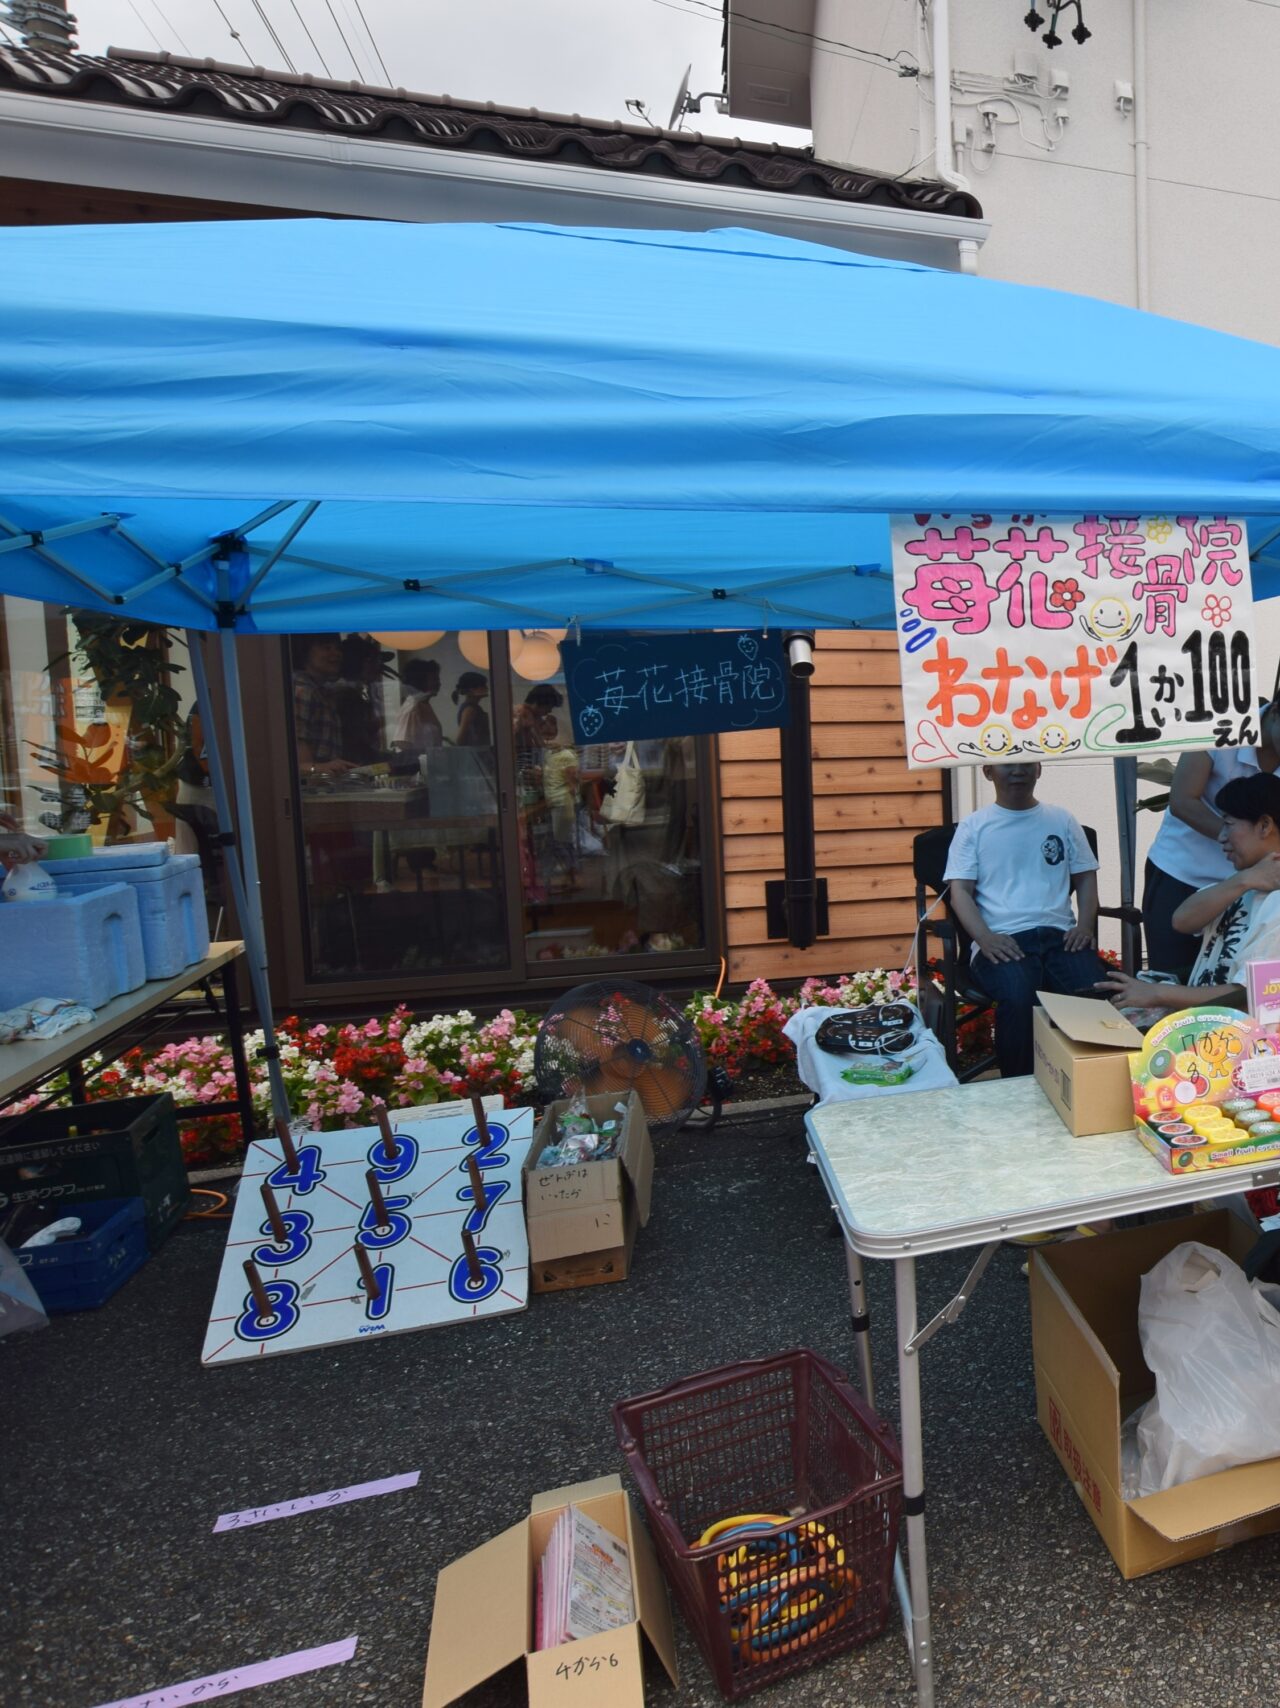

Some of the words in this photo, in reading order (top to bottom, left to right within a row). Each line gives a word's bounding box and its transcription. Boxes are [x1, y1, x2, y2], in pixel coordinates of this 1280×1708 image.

[921, 636, 1118, 729] わなげ
[266, 1144, 327, 1196] 4
[367, 1134, 419, 1184] 9
[459, 1122, 511, 1172] 2
[251, 1209, 314, 1268] 3
[355, 1195, 413, 1250] 5
[457, 1180, 511, 1234] 7
[234, 1278, 300, 1342] 8
[357, 1262, 395, 1320] 1
[448, 1246, 505, 1304] 6
[556, 1654, 619, 1680] 4から6
